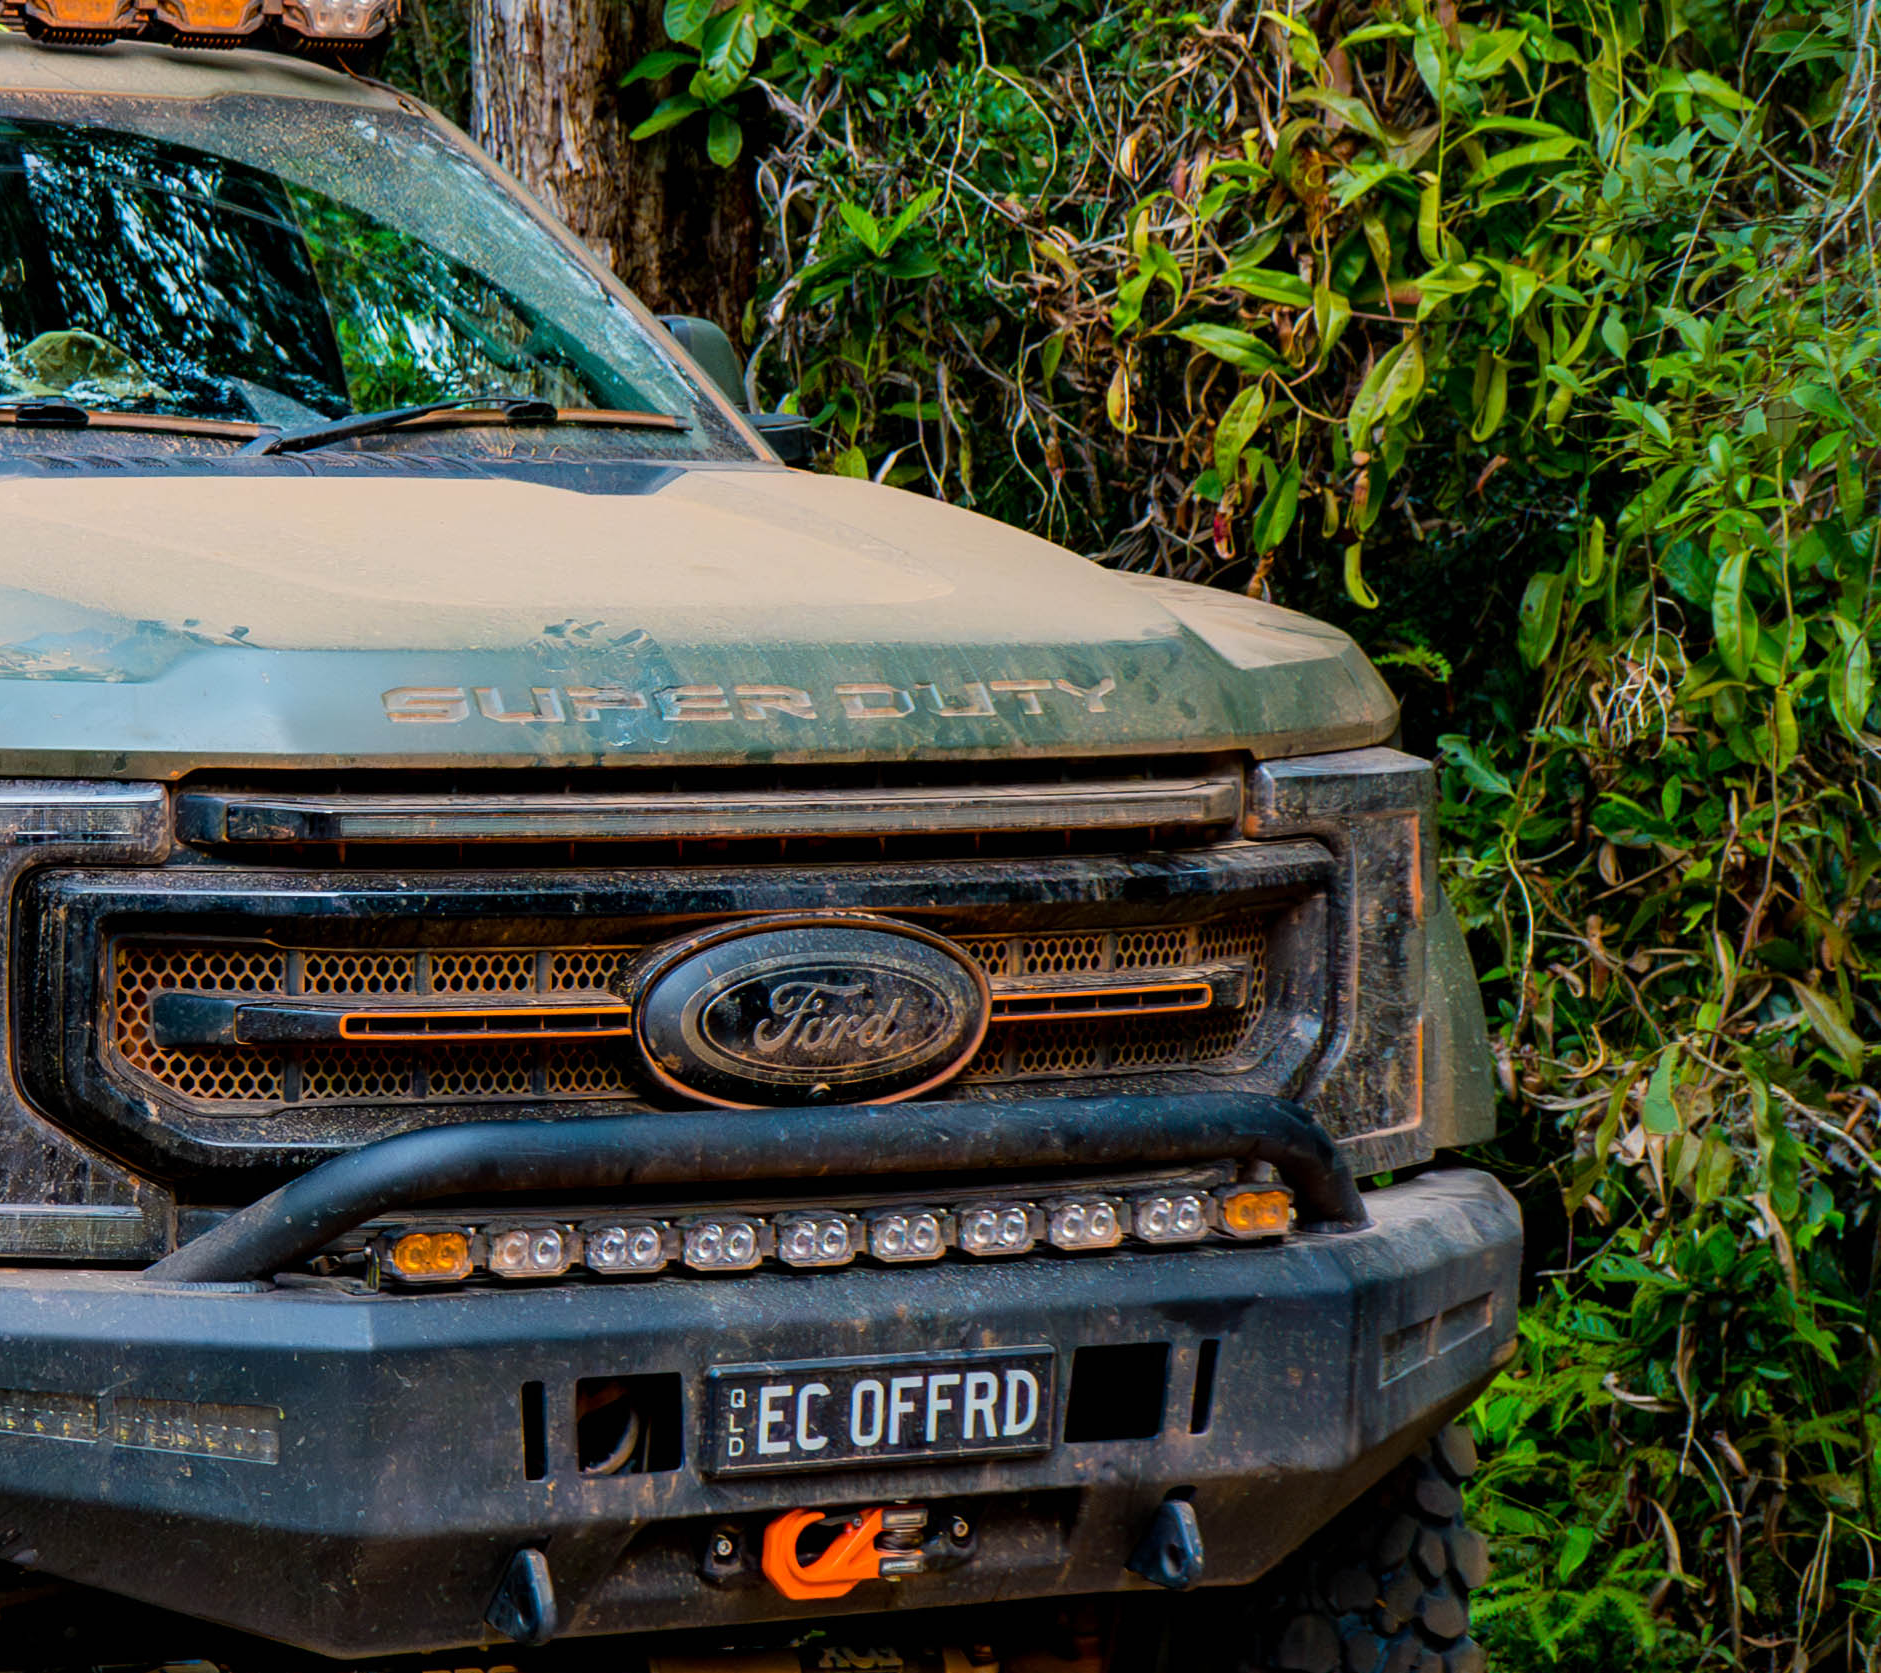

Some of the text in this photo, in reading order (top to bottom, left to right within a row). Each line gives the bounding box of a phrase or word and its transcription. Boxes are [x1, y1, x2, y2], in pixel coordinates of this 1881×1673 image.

[382, 676, 1116, 724] SUPER DUTY
[754, 981, 903, 1053] Ford
[728, 1388, 747, 1457] QLD
[757, 1369, 1039, 1455] EC OFFRD
